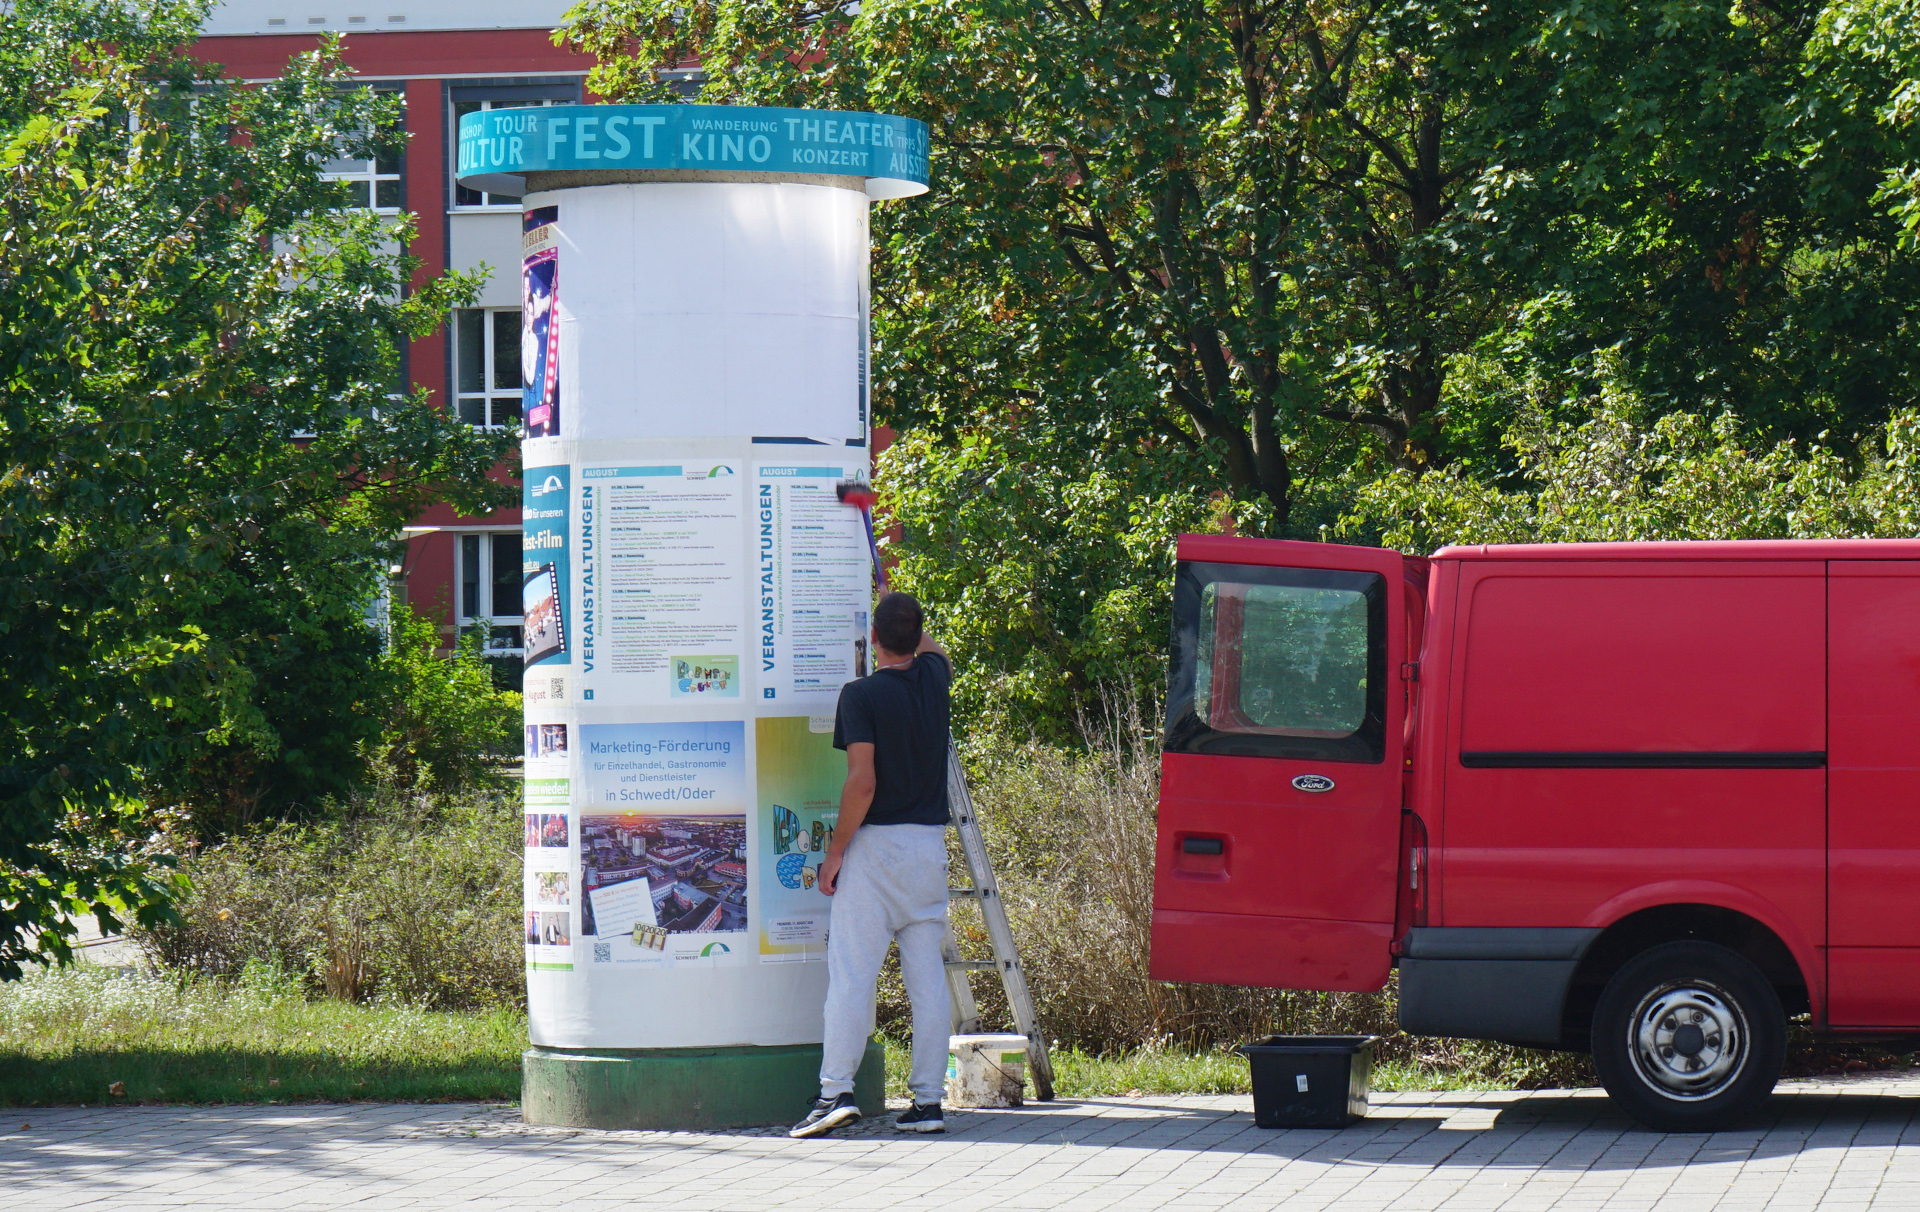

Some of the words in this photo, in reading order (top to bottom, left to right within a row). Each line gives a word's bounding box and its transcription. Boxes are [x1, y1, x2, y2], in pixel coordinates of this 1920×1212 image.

[494, 114, 538, 134] TOUR
[692, 119, 778, 133] WANDERUNG
[547, 115, 666, 160] FEST
[783, 117, 894, 148] THEATER
[682, 133, 771, 163] KINO
[897, 136, 916, 151] TIPPS
[459, 136, 524, 171] KULTUR
[792, 148, 869, 167] KONZERT
[584, 468, 619, 478] AUGUST
[762, 467, 798, 476] AUGUST
[540, 509, 564, 518] unseren
[582, 485, 594, 673] VERANSTALTUNGEN
[760, 484, 775, 672] VERANSTALTUNGEN
[590, 739, 731, 755] Marketing-Förderung
[594, 762, 605, 770] für
[608, 761, 665, 771] Einzelhandel,
[667, 759, 727, 769] Gastronomie
[620, 774, 637, 782] und
[639, 773, 697, 782] Dienstleister
[541, 781, 568, 795] wieder!
[606, 789, 616, 801] in
[620, 786, 716, 801] Schwedt/Oder
